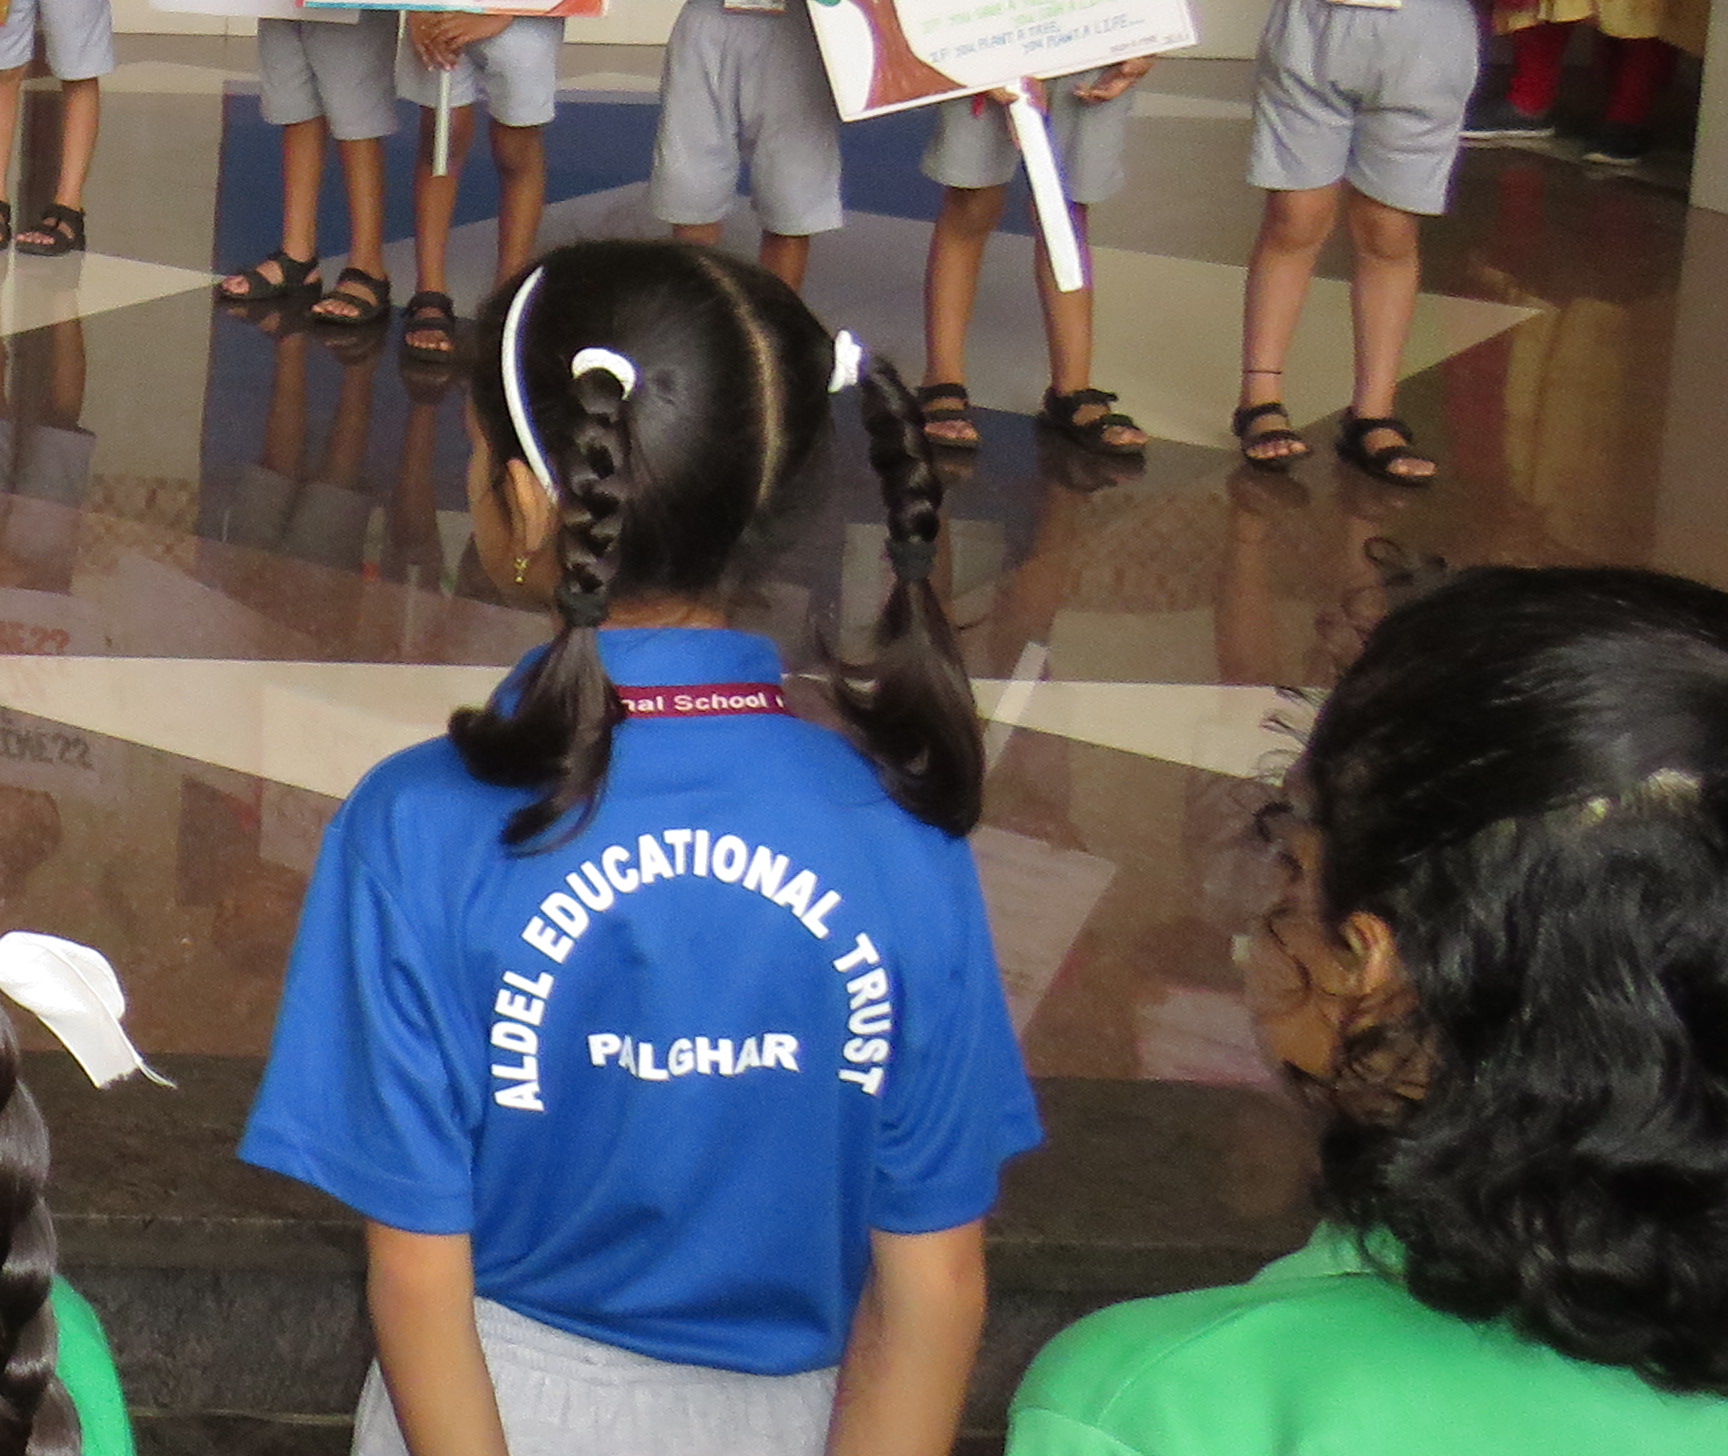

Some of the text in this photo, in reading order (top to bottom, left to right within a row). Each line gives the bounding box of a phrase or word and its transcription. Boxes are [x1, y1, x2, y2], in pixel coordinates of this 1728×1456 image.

[673, 691, 768, 711] School
[490, 827, 893, 1111] ALDEL EDUCATIONAL TRUST
[587, 1032, 800, 1081] PALGHAR
